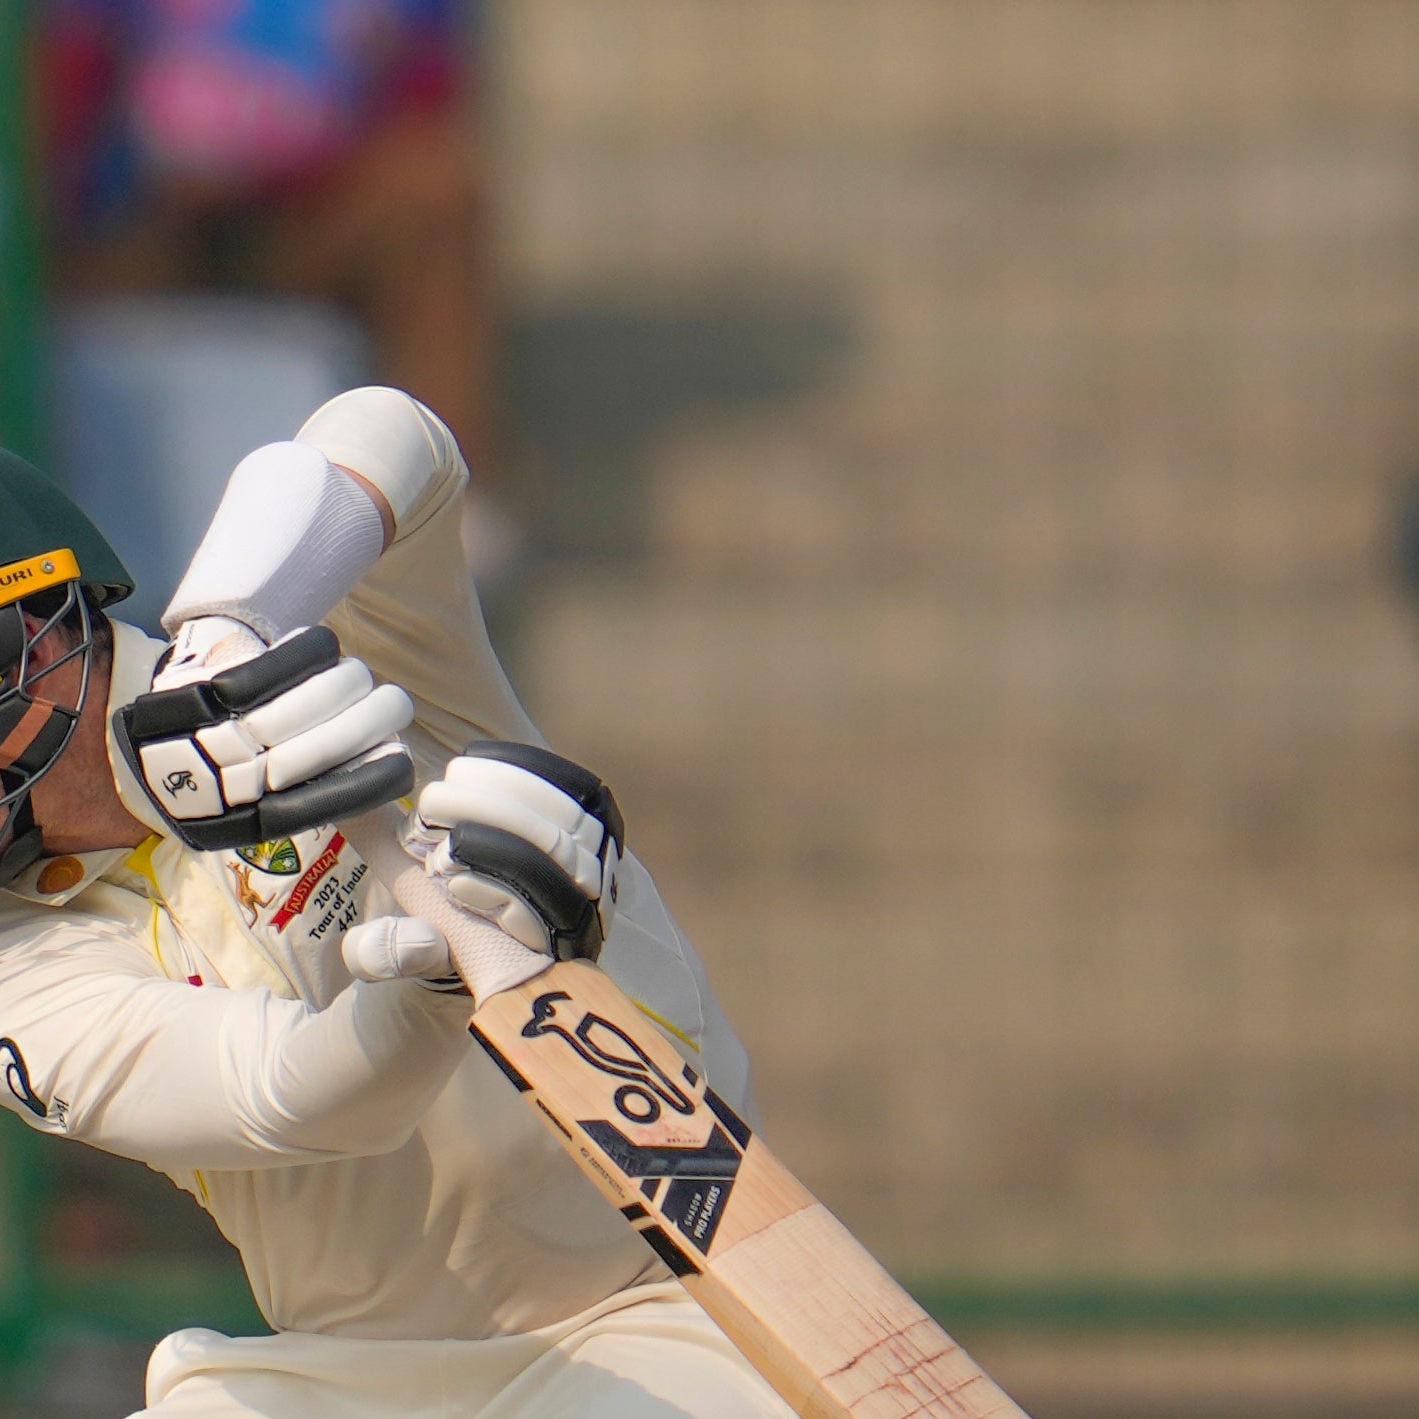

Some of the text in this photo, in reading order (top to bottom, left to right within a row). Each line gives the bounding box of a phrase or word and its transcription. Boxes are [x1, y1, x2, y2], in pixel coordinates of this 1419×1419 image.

[289, 850, 338, 912] AUSTRALIA
[309, 862, 369, 942] Tour of India
[313, 875, 341, 911] 2023
[337, 901, 359, 934] 447
